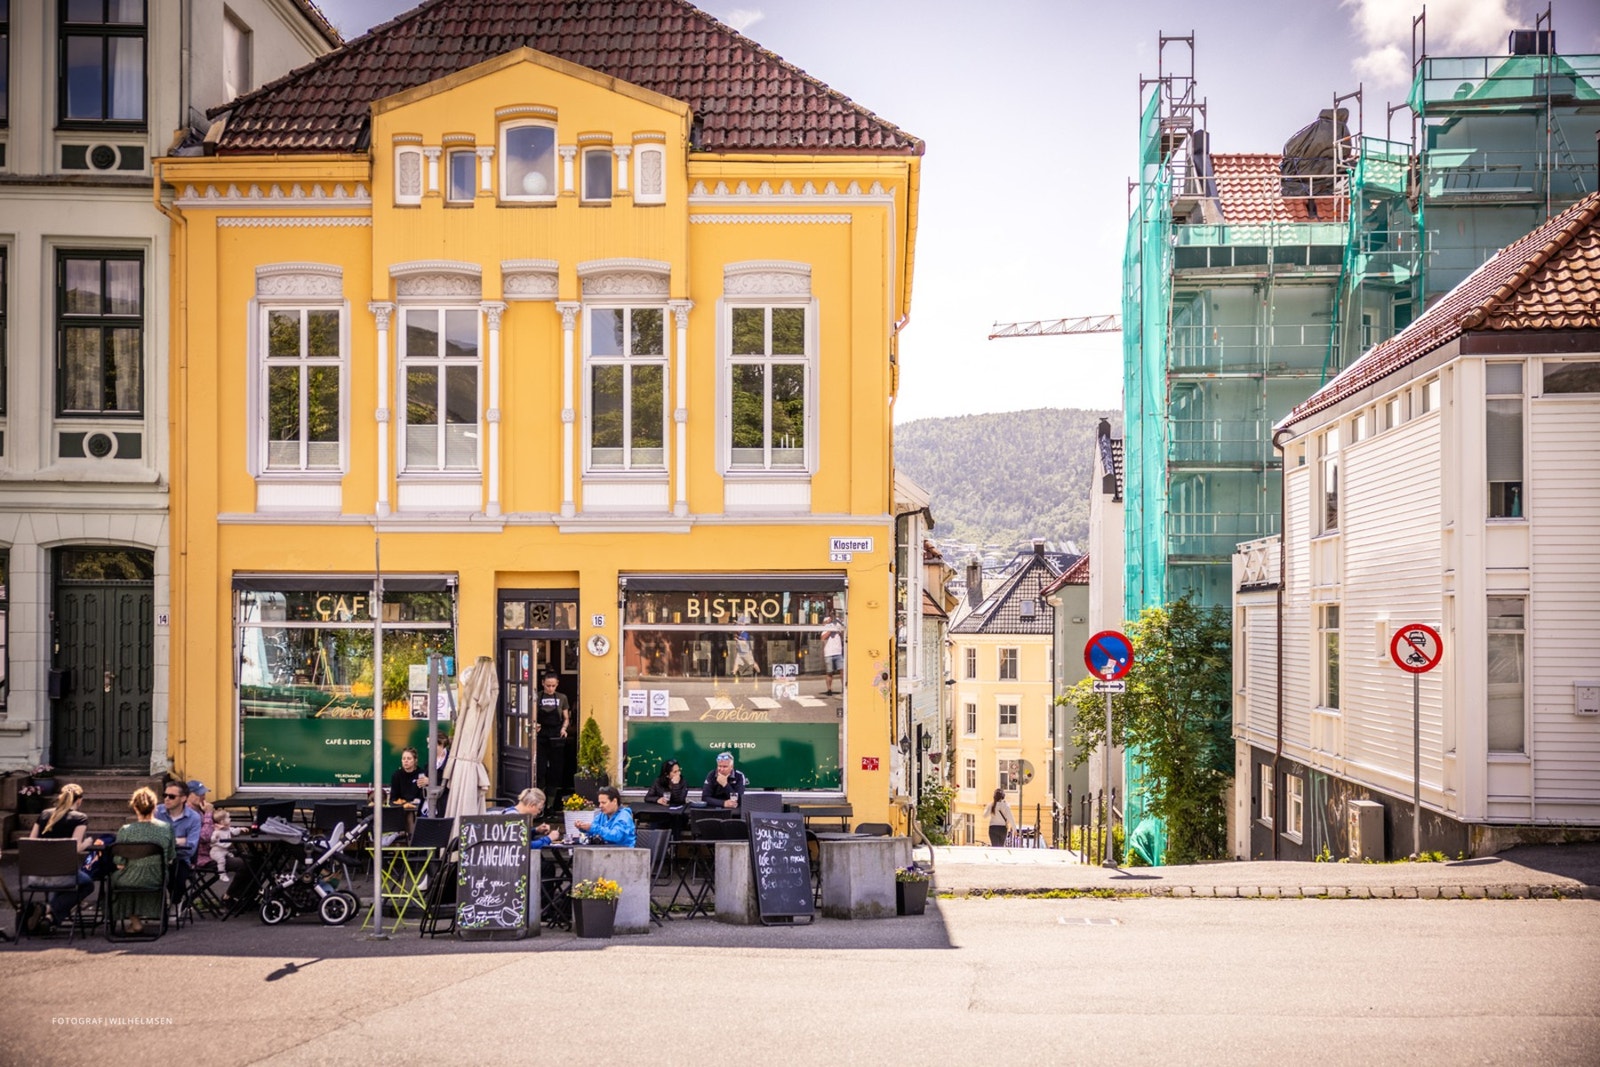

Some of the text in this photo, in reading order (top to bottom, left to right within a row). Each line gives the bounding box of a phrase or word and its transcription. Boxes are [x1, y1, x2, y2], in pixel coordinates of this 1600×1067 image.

[833, 540, 869, 549] Klosteret
[316, 595, 372, 615] CAF
[687, 598, 780, 618] BISTRO
[159, 615, 167, 624] 14
[594, 616, 603, 625] 16
[709, 741, 726, 749] CAFÉ
[468, 823, 519, 844] A LOVE
[470, 845, 521, 867] LANGUAGE
[770, 856, 789, 864] cn
